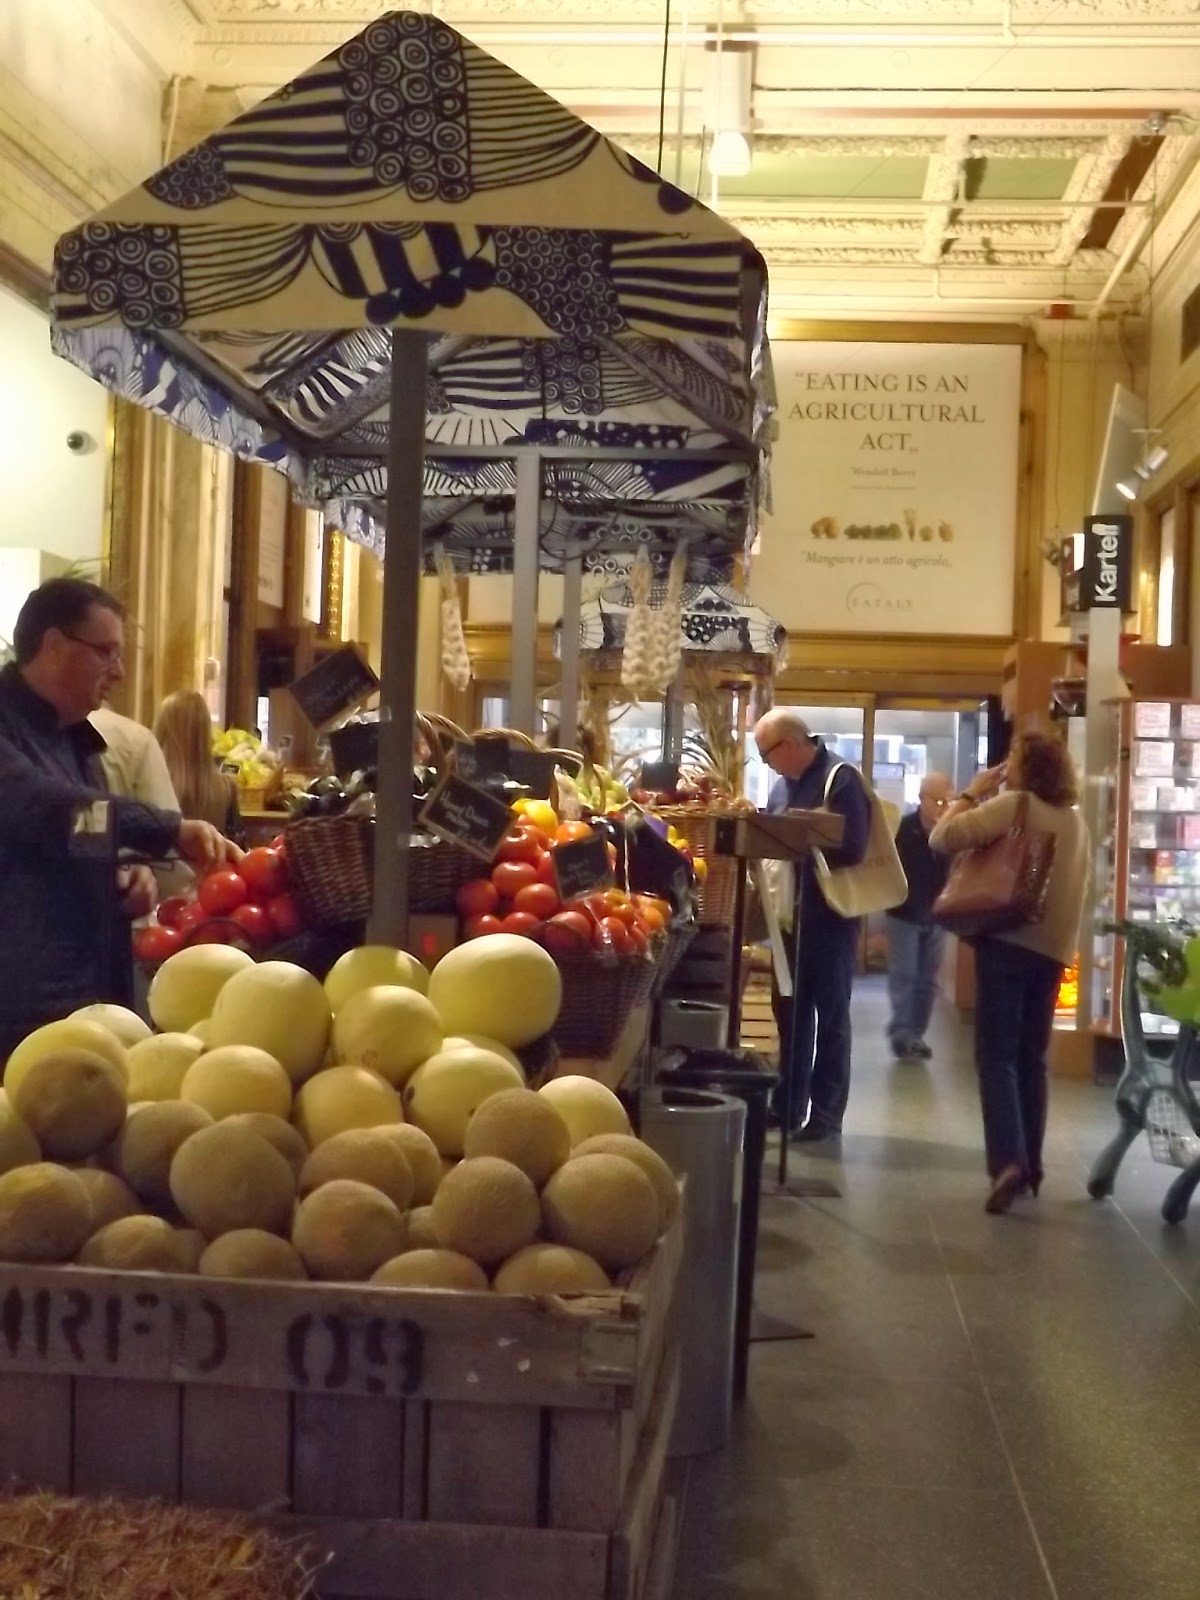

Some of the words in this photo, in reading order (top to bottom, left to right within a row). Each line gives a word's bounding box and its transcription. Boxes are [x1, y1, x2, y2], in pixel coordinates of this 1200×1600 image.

[906, 373, 928, 393] IS
[934, 374, 969, 393] AN
[788, 401, 986, 423] AGRICULTURAL
[866, 556, 880, 566] un
[883, 556, 904, 567] atto
[1091, 523, 1120, 603] Kartell
[852, 597, 914, 609] EATALY
[287, 1310, 426, 1395] 09
